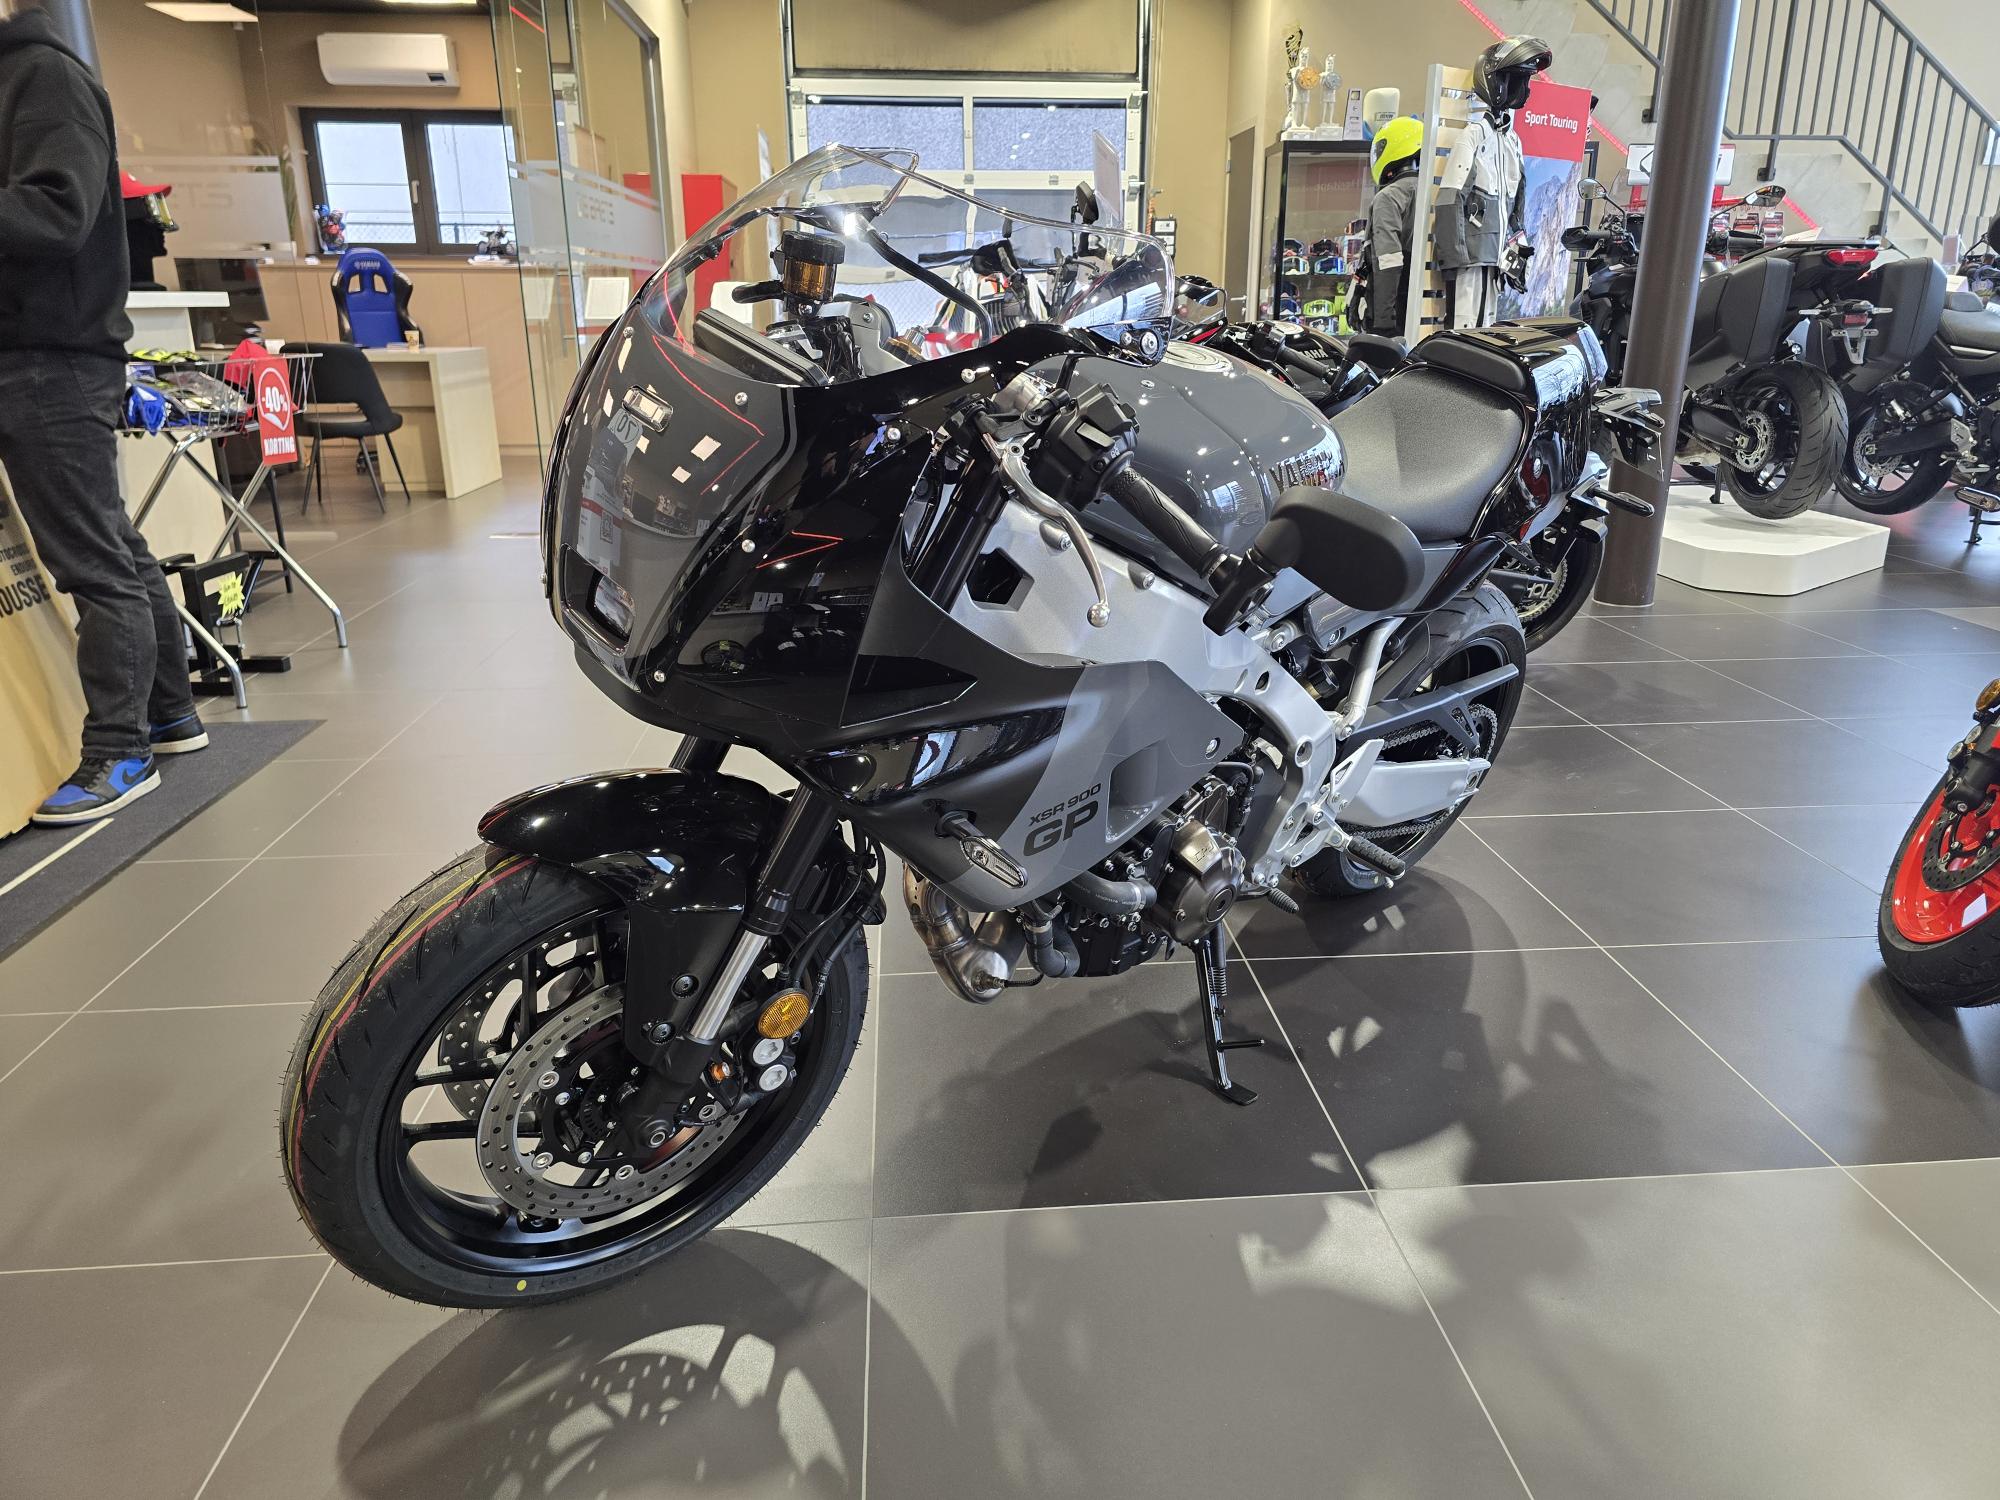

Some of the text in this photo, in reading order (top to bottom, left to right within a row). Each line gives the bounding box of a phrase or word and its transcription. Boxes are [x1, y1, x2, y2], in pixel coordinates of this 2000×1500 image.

[1524, 110, 1578, 134] Sport Touring
[1303, 348, 1329, 359] AHA
[261, 386, 288, 412] -40%
[263, 436, 296, 457] KORTING
[1027, 782, 1102, 827] XSR 900
[1023, 800, 1099, 857] GP
